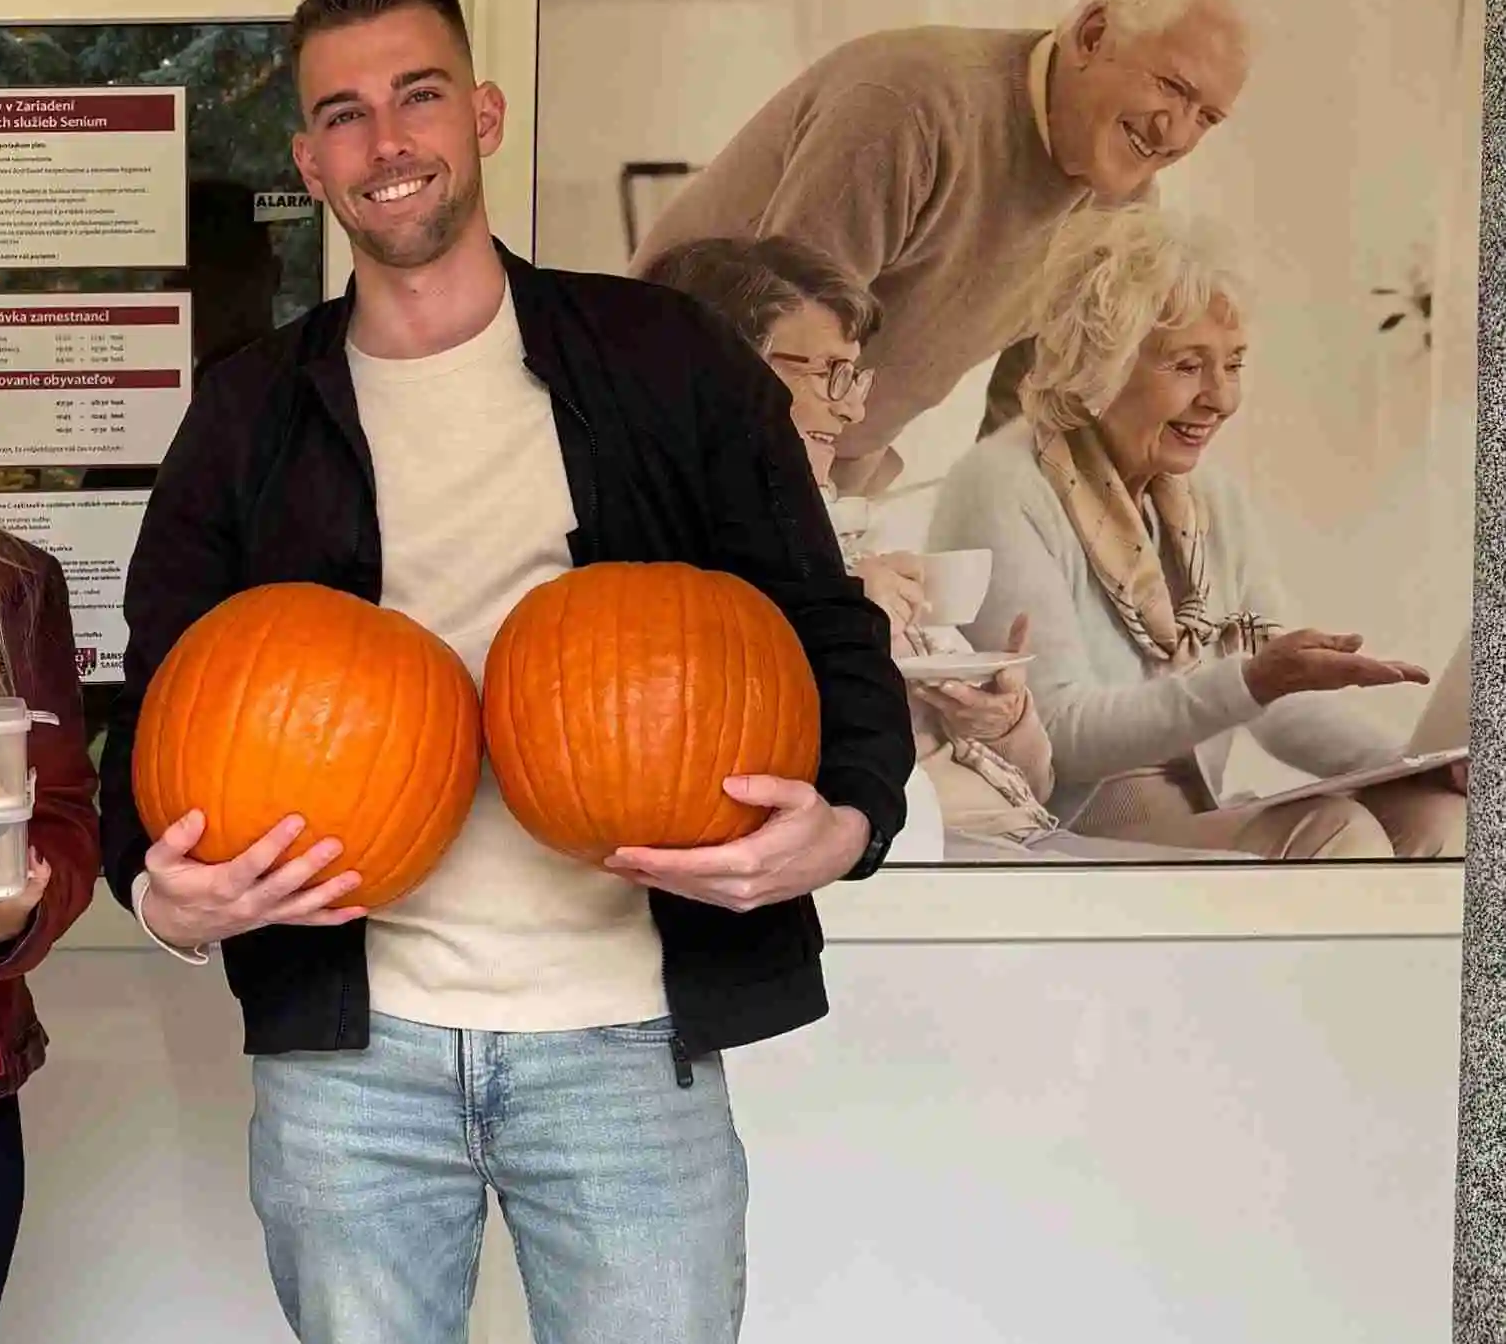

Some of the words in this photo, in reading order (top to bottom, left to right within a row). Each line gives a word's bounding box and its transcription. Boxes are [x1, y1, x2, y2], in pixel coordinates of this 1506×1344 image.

[6, 103, 13, 112] v
[16, 100, 75, 112] Zariadení
[13, 115, 57, 128] služieb
[60, 116, 107, 128] Senium
[256, 195, 312, 207] ALARM
[30, 309, 110, 323] zamestnanci
[43, 373, 116, 389] obyvateľov
